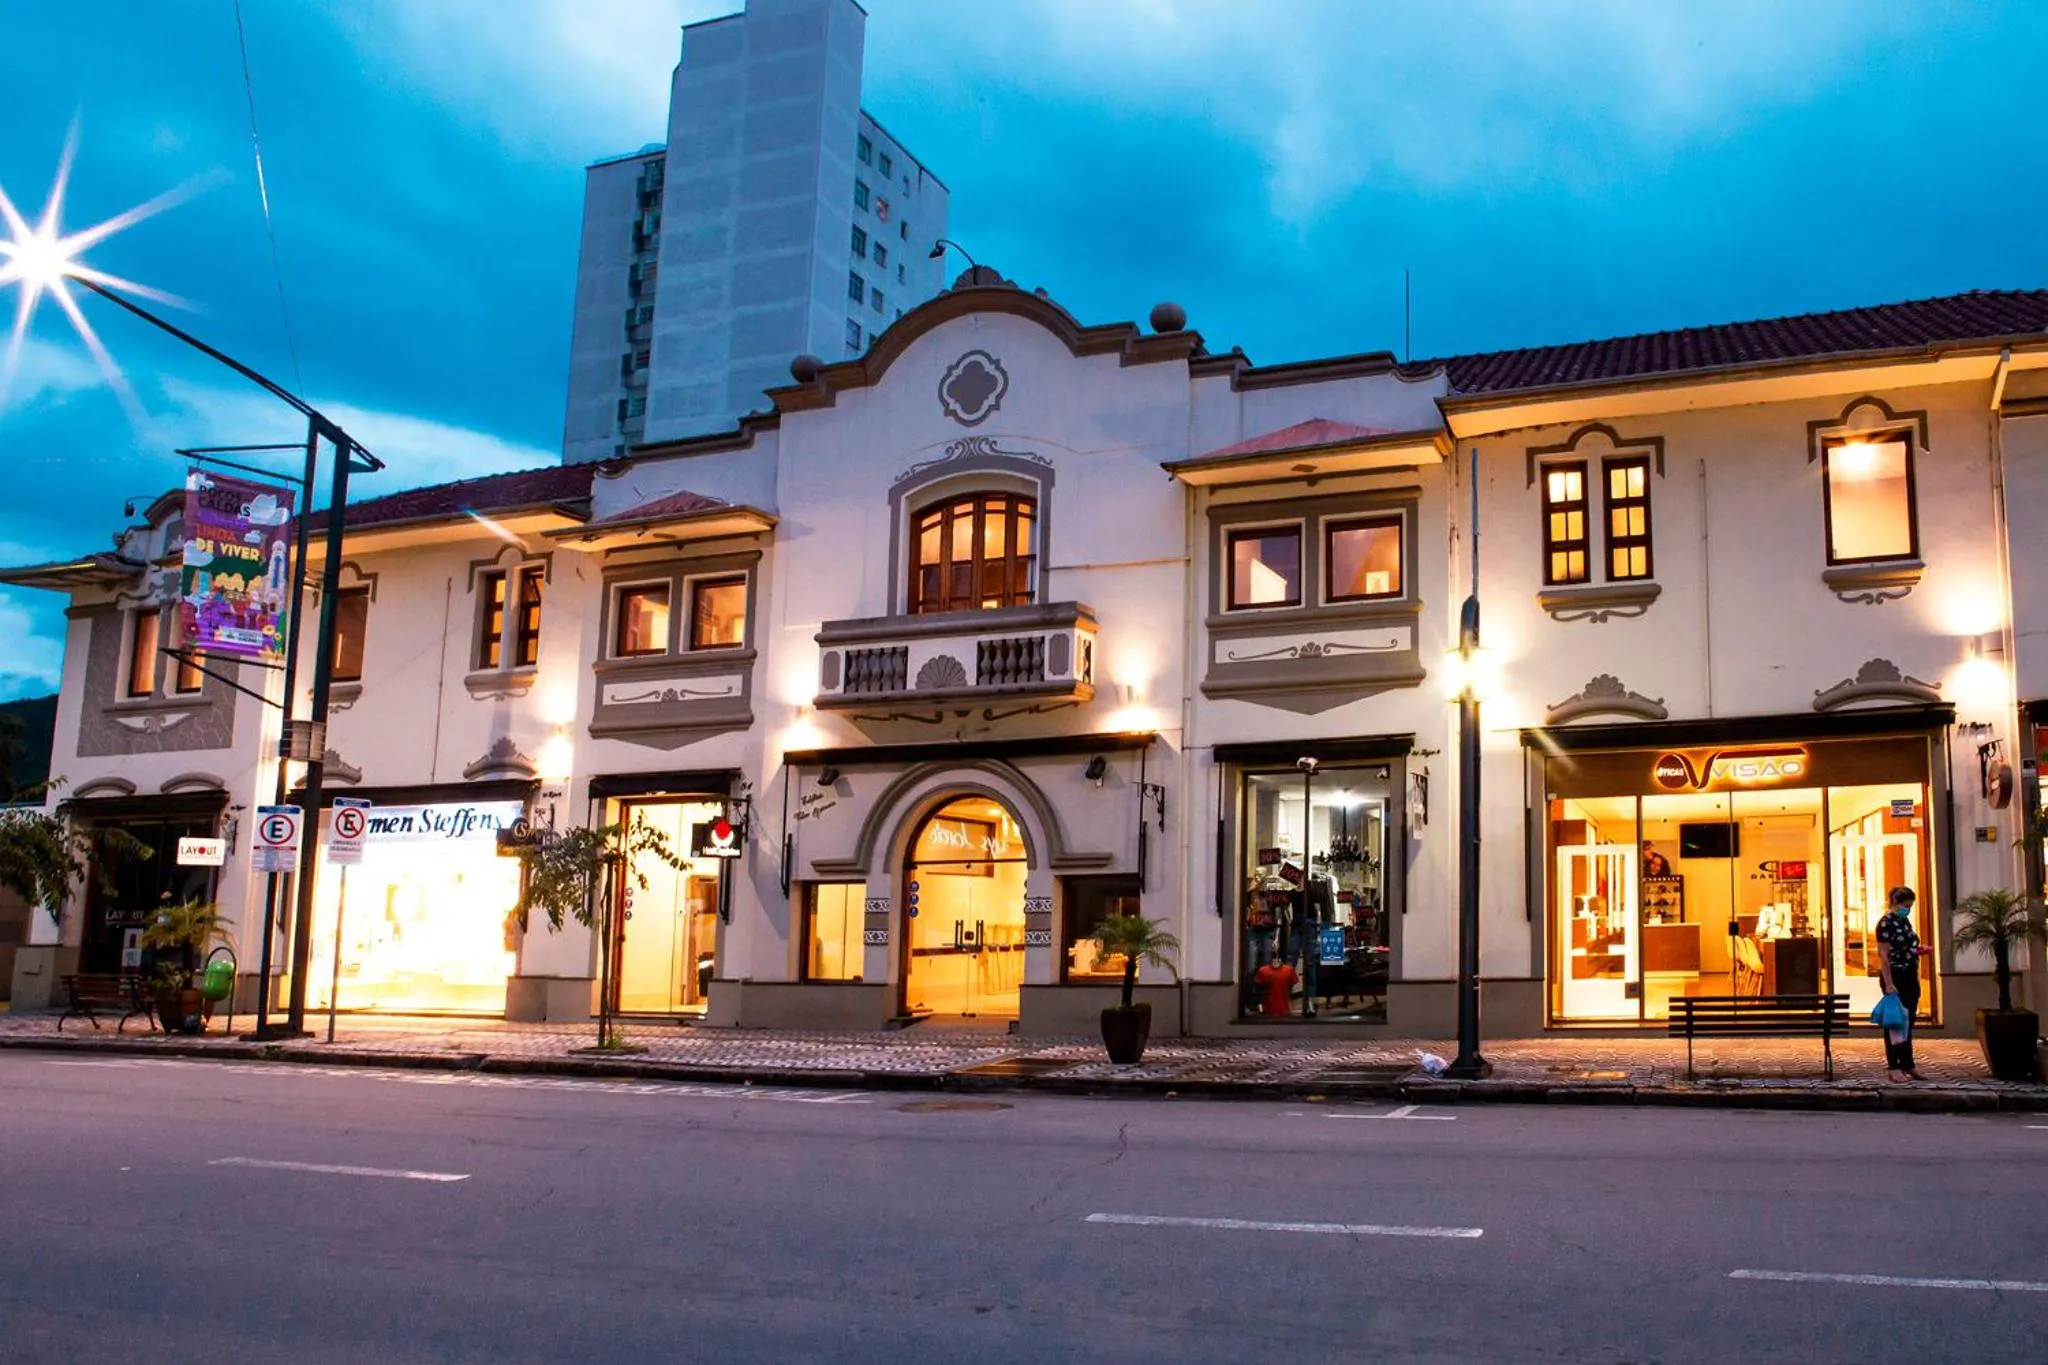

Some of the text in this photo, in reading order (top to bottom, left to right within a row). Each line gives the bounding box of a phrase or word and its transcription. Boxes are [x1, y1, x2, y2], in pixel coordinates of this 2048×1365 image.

[195, 537, 260, 562] DE VIVER
[270, 820, 285, 838] E
[343, 813, 356, 831] E
[368, 816, 413, 834] men
[419, 807, 502, 839] Steffens
[180, 846, 217, 856] LAYOUT
[105, 909, 145, 921] LAYUT
